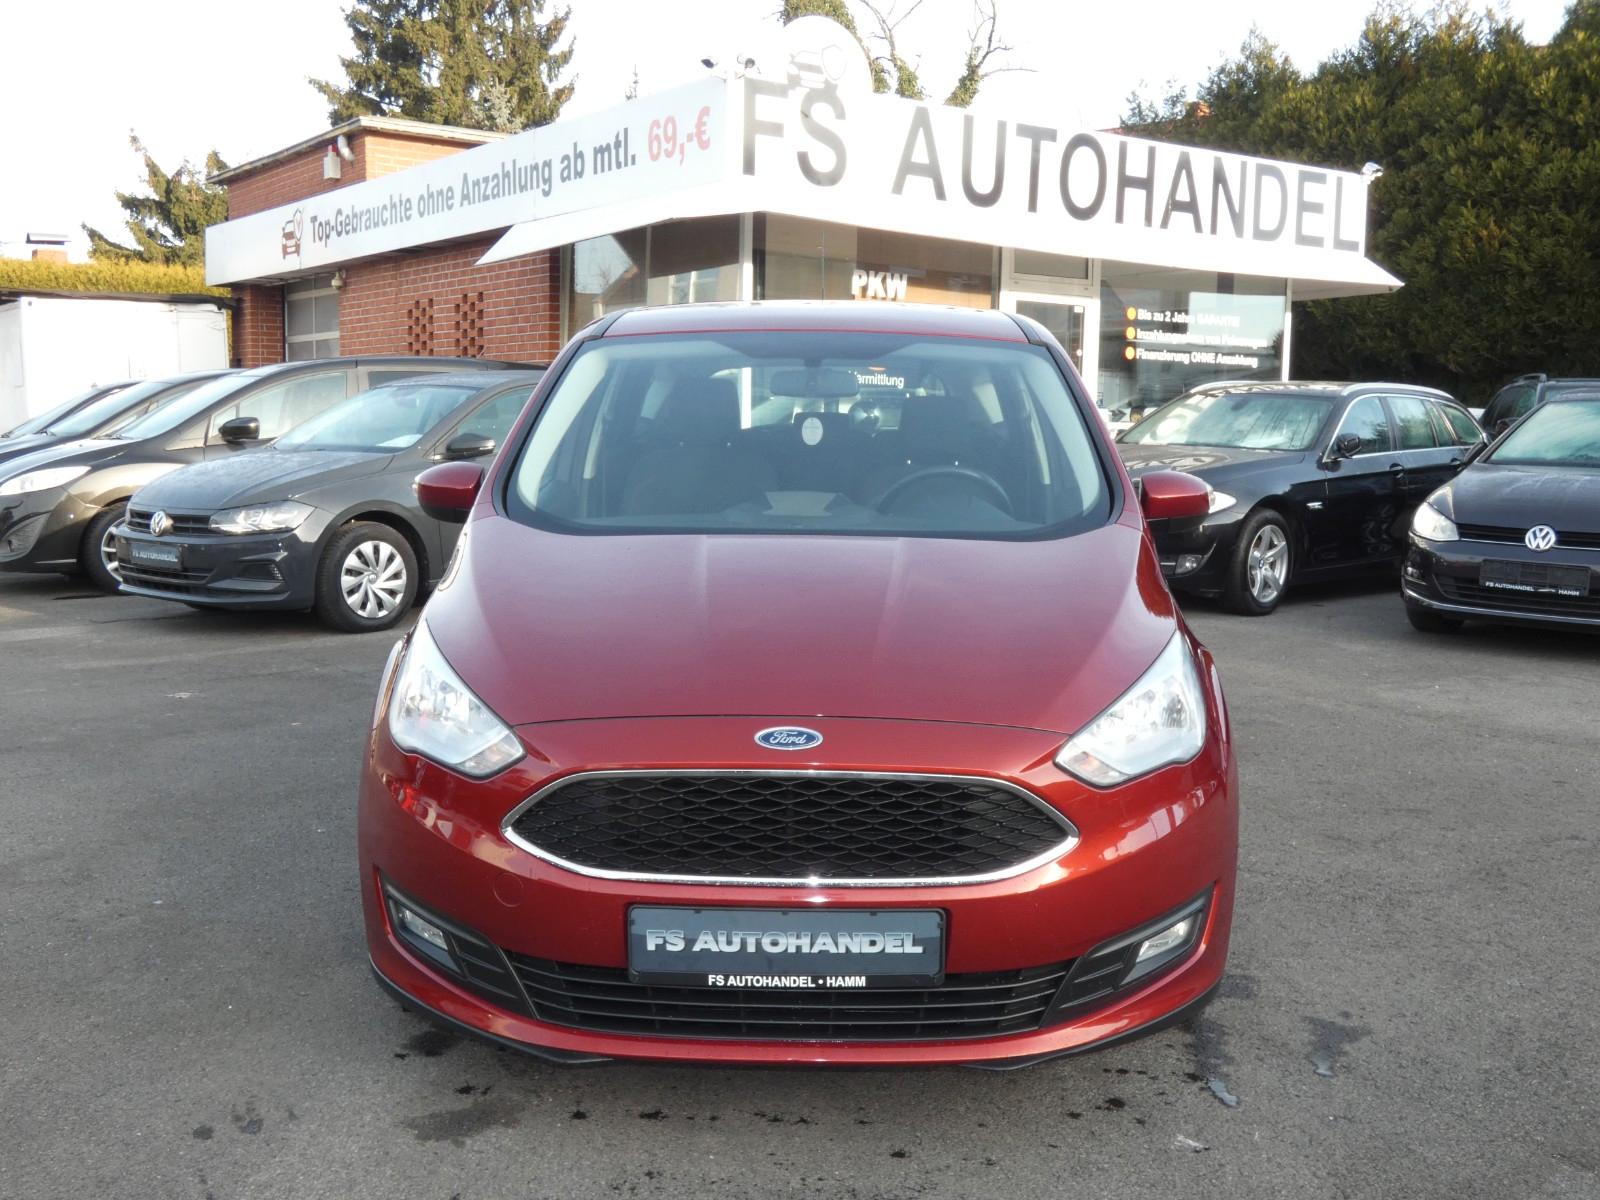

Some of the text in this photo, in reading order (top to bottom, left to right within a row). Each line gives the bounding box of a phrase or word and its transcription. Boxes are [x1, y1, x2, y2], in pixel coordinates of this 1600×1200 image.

[742, 76, 1361, 252] FS AUTOHANDEL
[310, 105, 711, 248] Top-Gebrauchte ohne Anzahlung ab mtl. 69,-€
[851, 269, 909, 301] PKW
[1137, 308, 1152, 321] Bis
[1153, 312, 1164, 322] zu
[1165, 311, 1171, 322] 2
[1136, 348, 1190, 364] Finanzierung
[1191, 351, 1216, 363] OHNE
[855, 372, 905, 389] ermittlung
[769, 731, 808, 744] Ford
[646, 929, 924, 954] FS AUTOHANDEL
[708, 974, 867, 988] FS AUTOHANDEL HAMM
